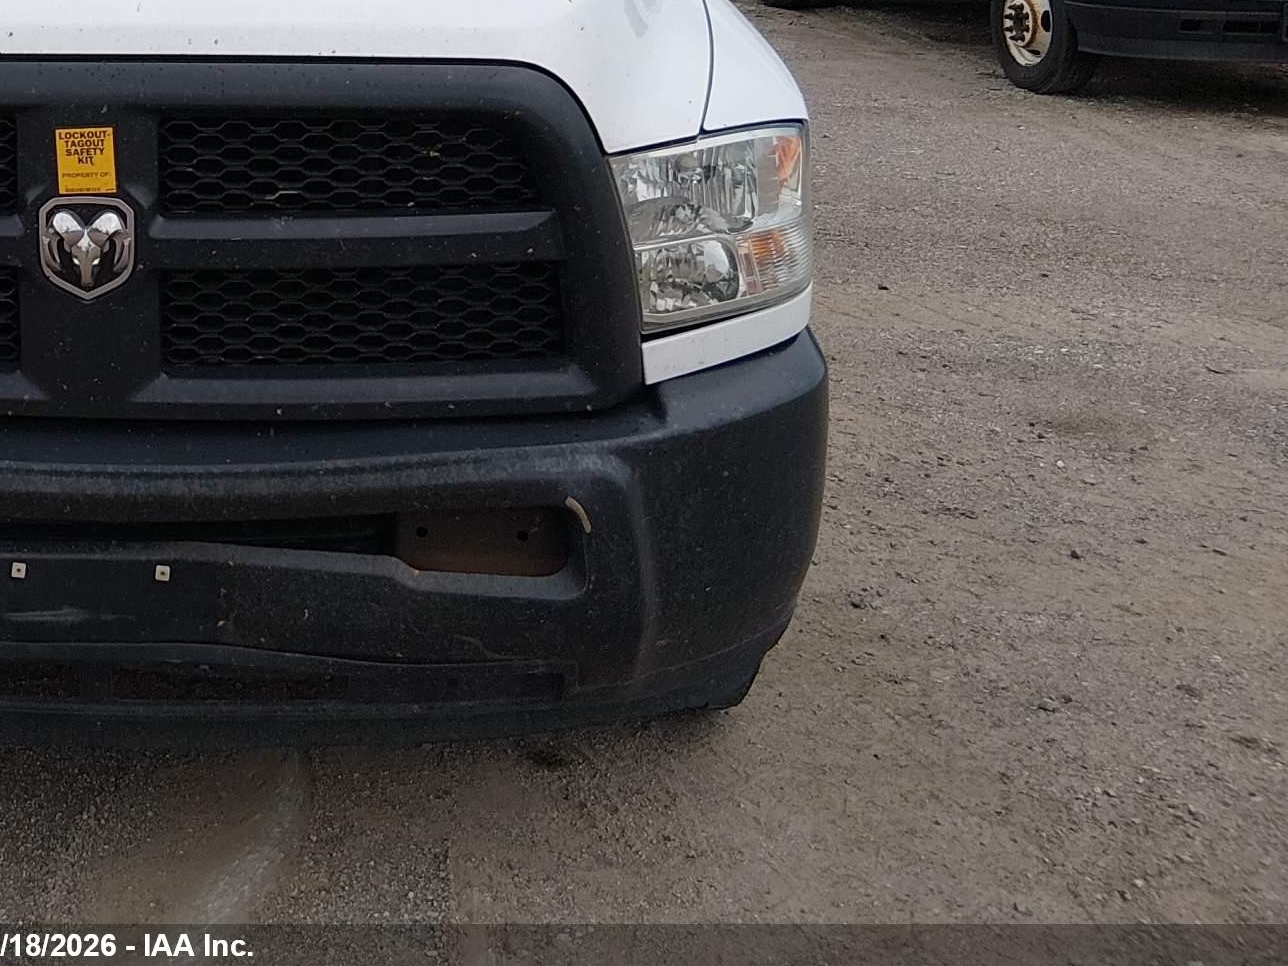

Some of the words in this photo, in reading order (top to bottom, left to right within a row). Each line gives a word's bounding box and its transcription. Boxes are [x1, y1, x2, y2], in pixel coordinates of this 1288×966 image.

[59, 130, 110, 140] LOCKOUT-
[64, 139, 104, 148] TAGOUT
[66, 148, 104, 156] SAFETY
[78, 156, 94, 166] KIT
